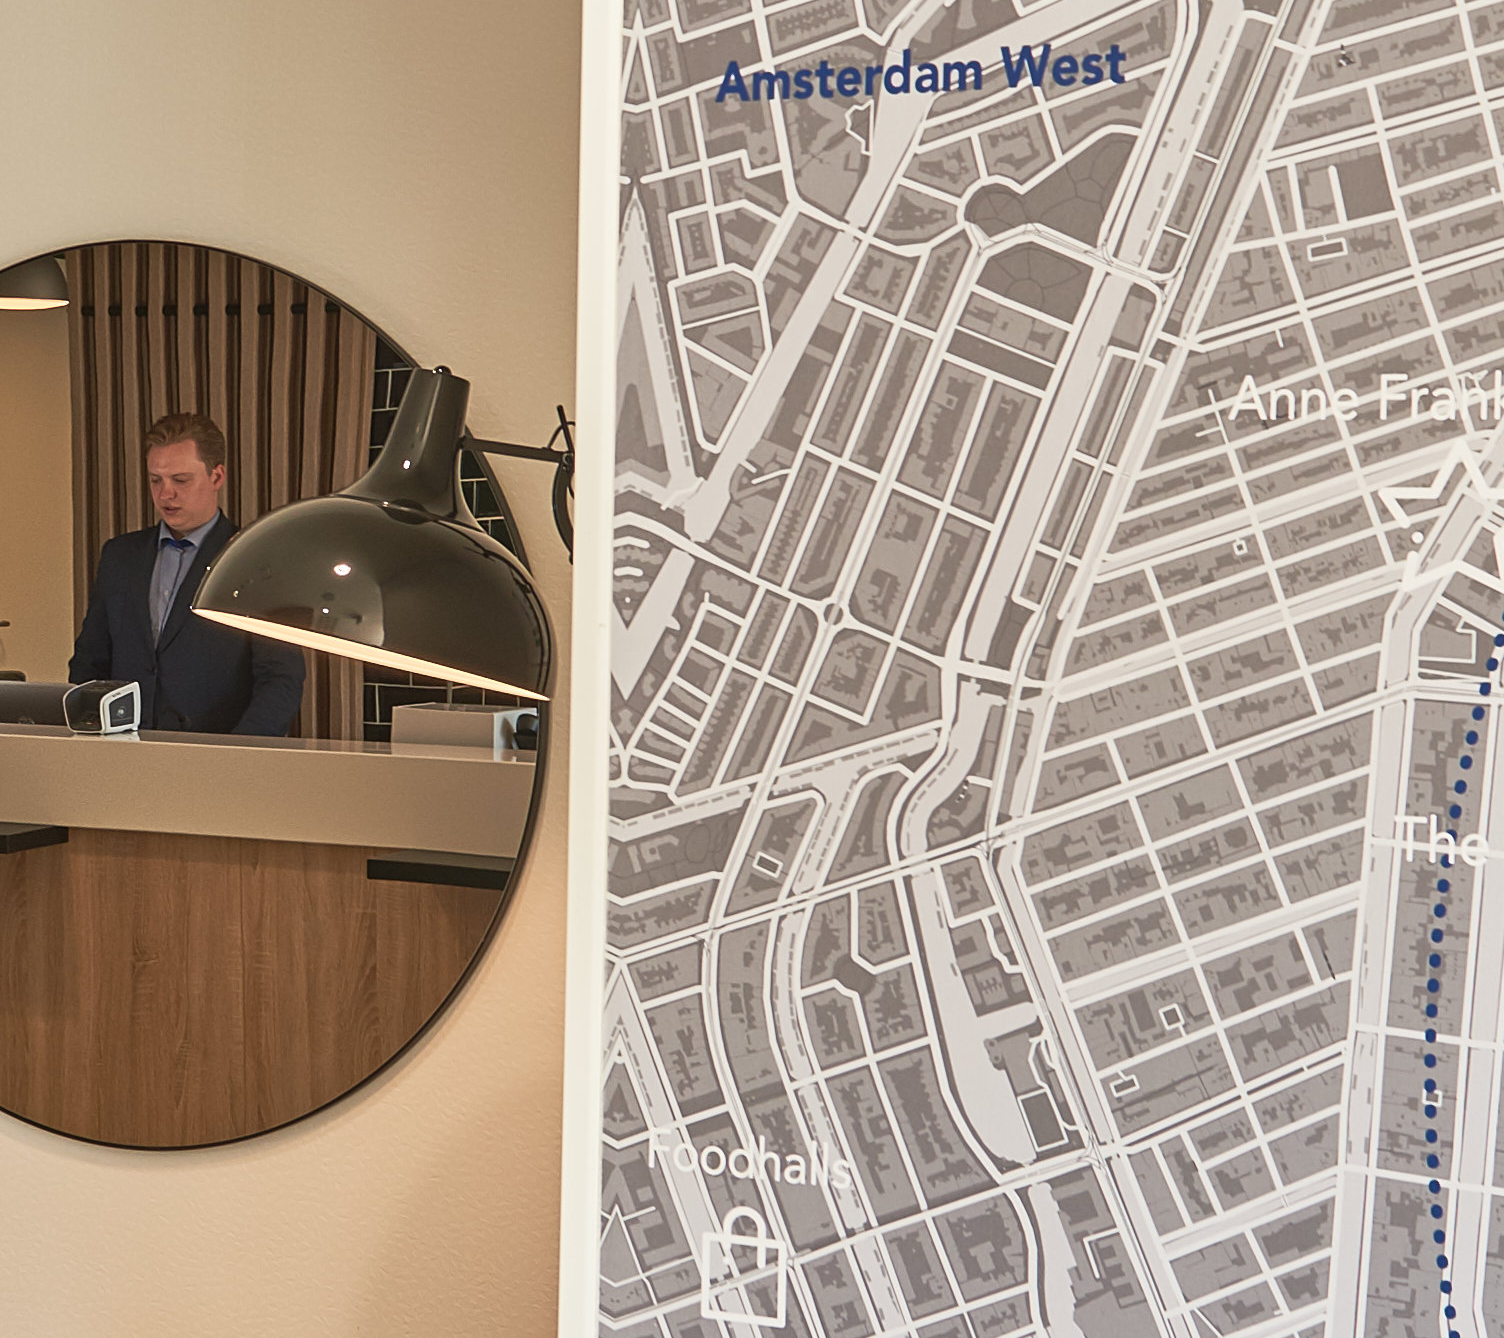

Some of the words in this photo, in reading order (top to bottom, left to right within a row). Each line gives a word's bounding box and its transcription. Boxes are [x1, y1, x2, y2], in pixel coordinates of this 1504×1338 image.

[715, 49, 983, 103] Amsterdam
[1000, 43, 1127, 89] West
[1228, 374, 1359, 421] Anne
[1395, 813, 1489, 865] The
[647, 1127, 852, 1190] Foodhalls
